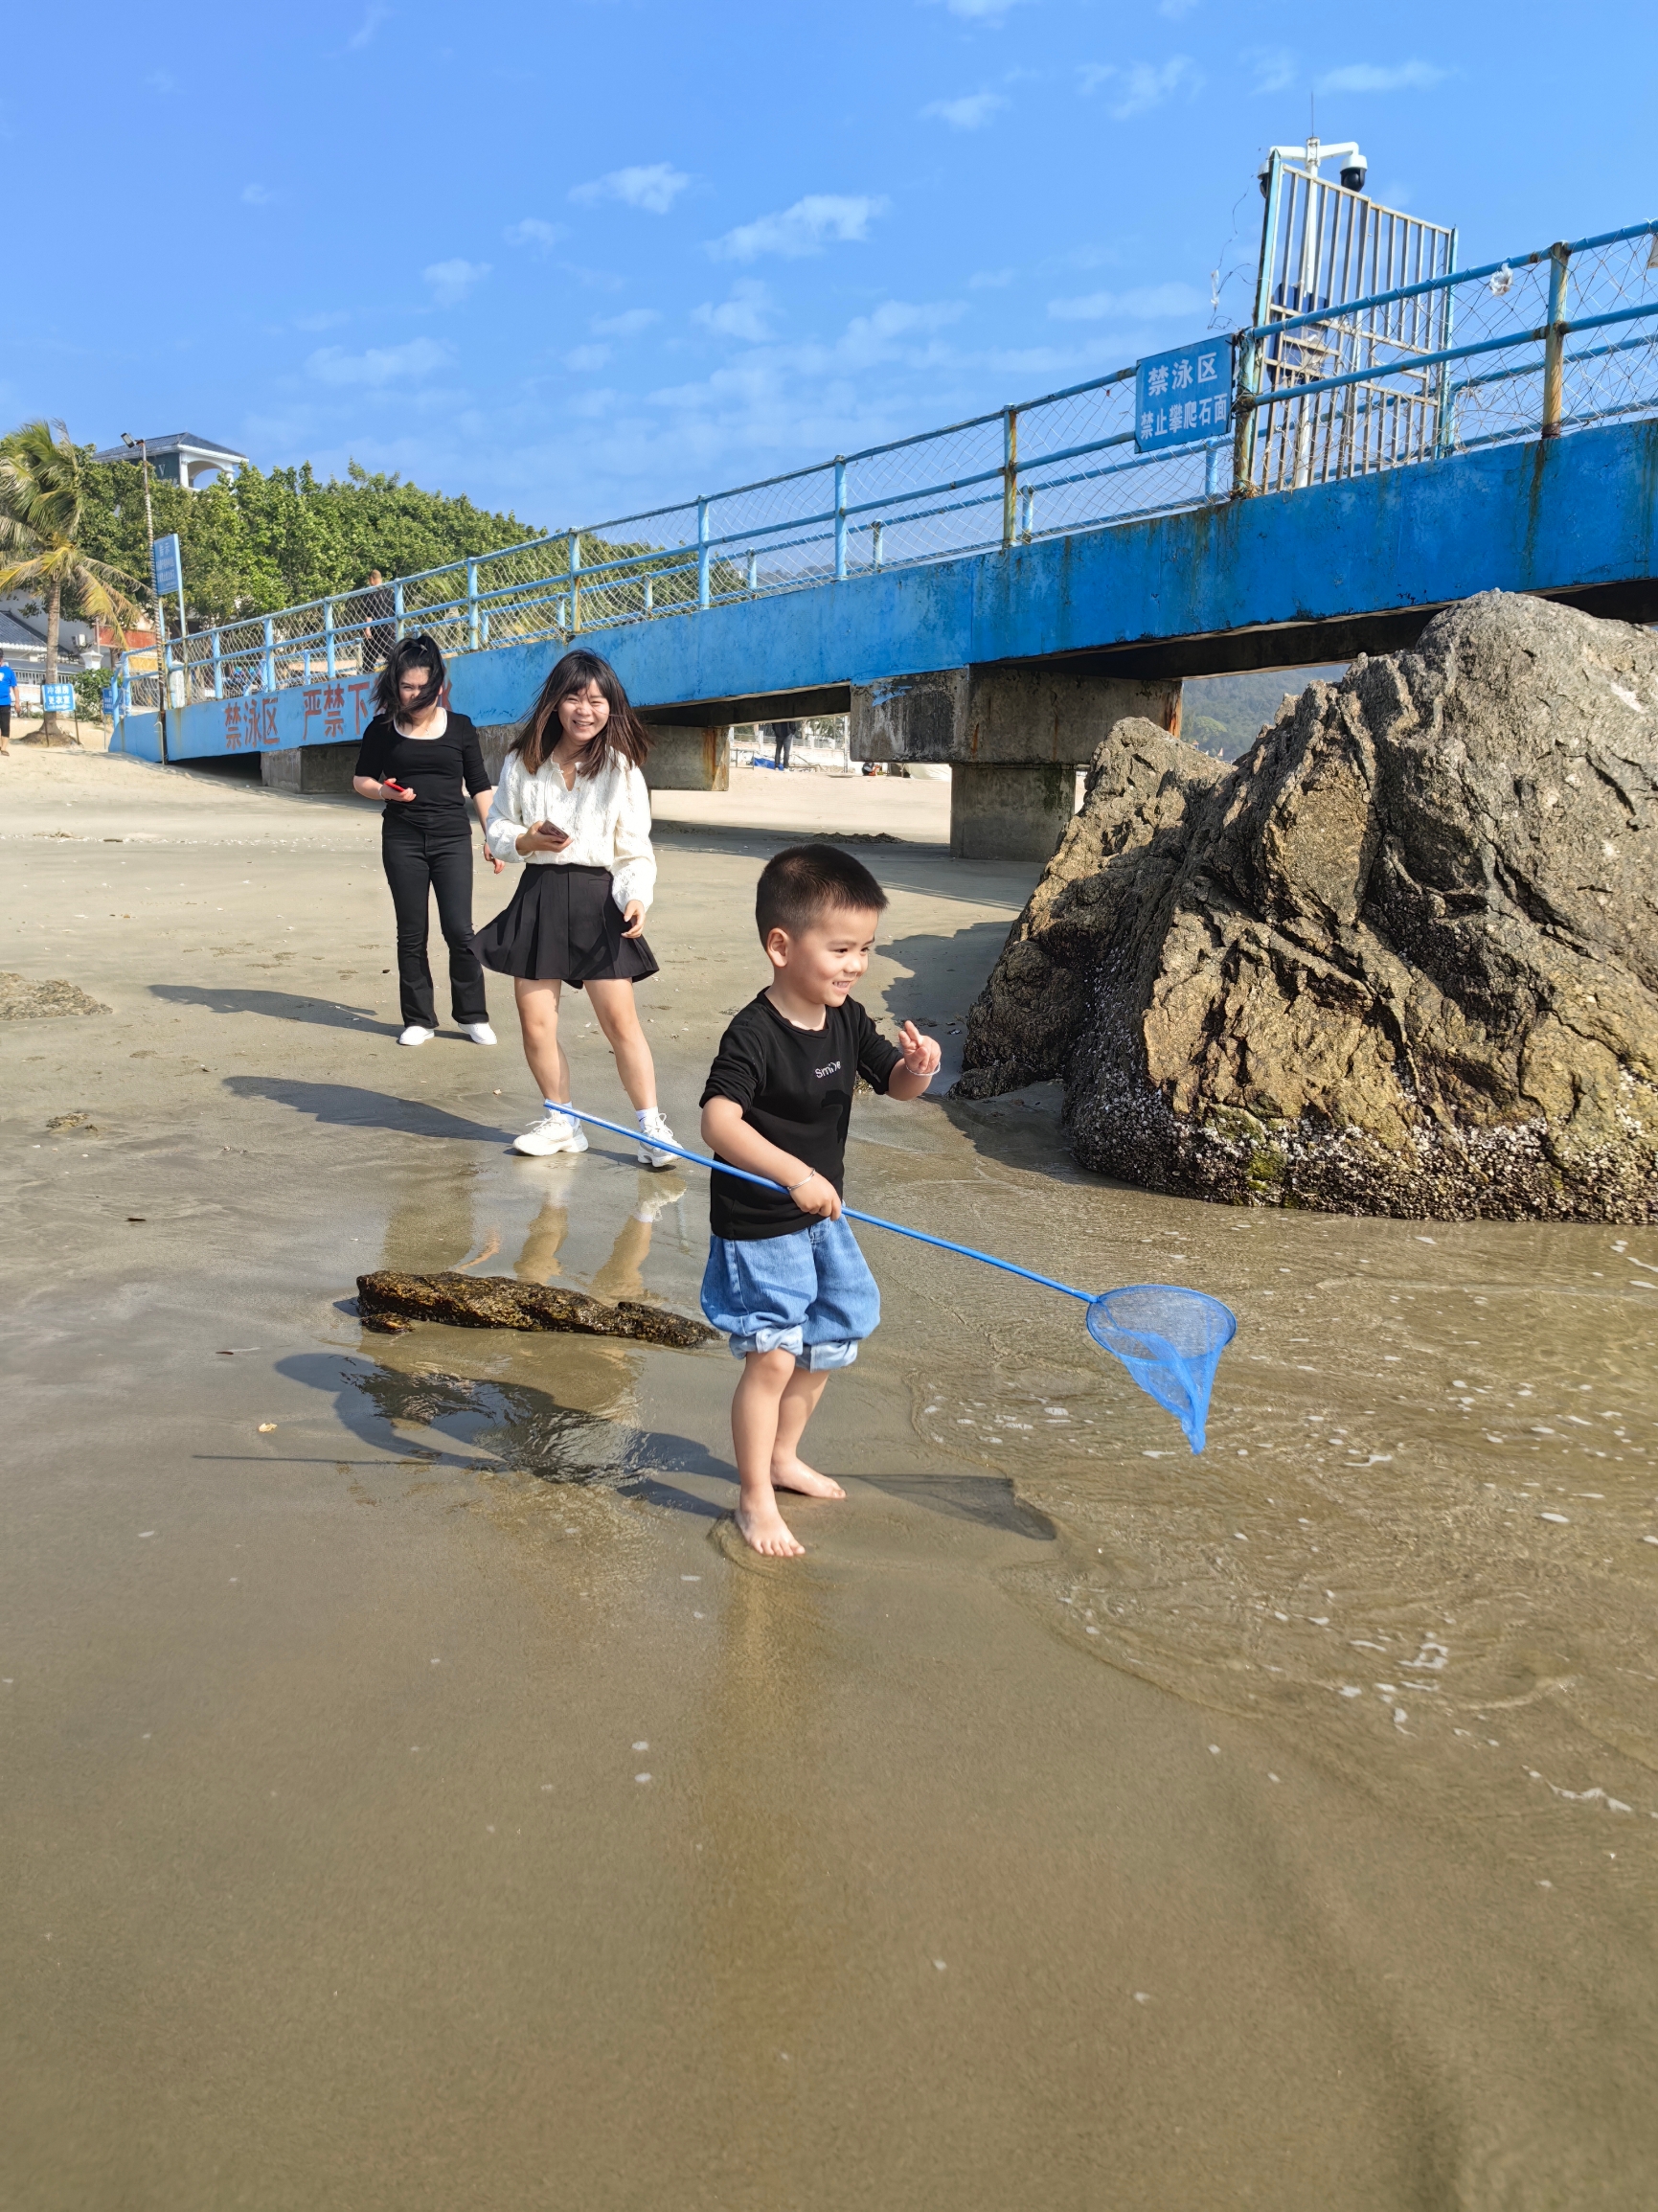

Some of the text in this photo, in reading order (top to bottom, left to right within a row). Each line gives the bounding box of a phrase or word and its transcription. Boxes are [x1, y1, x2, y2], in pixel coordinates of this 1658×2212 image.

[1147, 353, 1218, 397] 禁泳区
[1140, 393, 1228, 440] 禁止攀爬石面
[224, 697, 280, 750] 禁泳区
